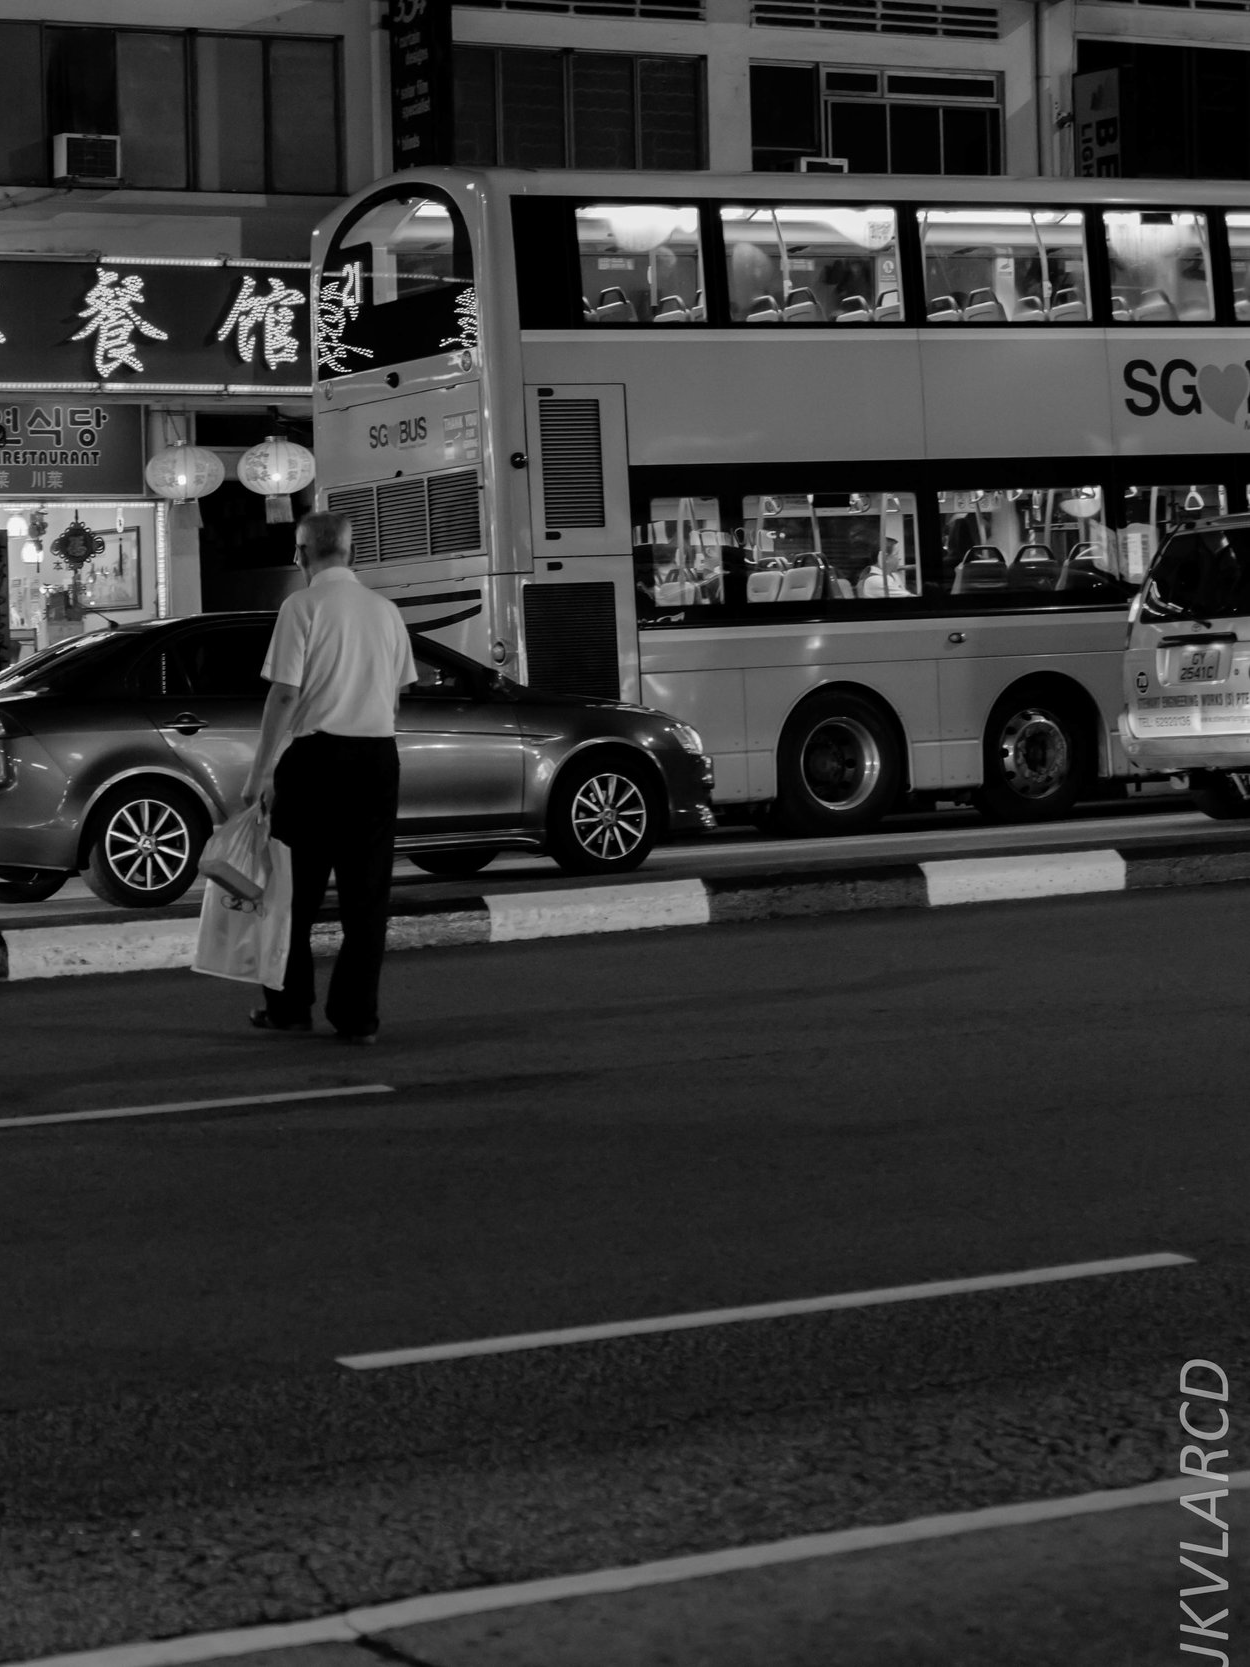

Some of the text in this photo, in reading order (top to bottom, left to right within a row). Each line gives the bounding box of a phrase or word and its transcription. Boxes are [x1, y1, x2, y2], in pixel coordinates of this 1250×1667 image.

[342, 261, 362, 306] 21
[399, 416, 428, 443] BUS
[1191, 652, 1207, 665] GY
[1201, 693, 1223, 706] WORKS
[1236, 692, 1250, 706] PTE
